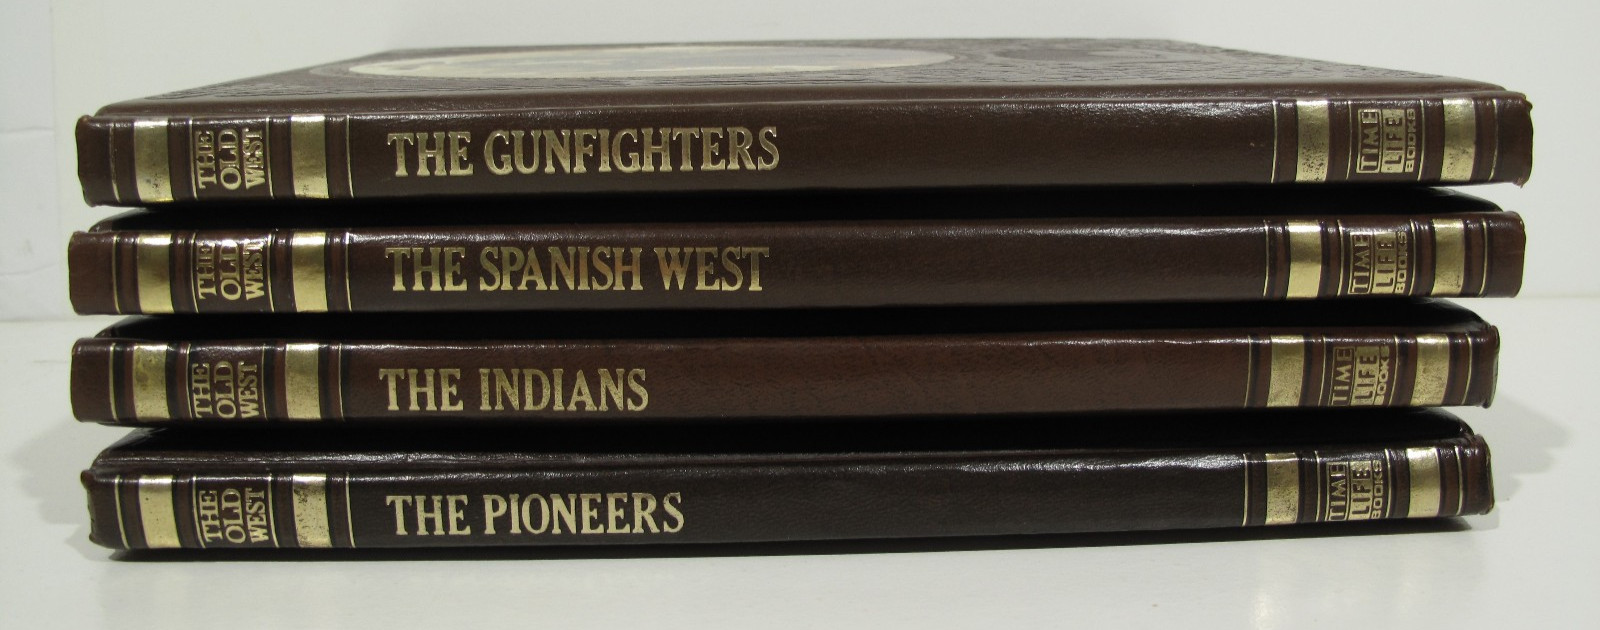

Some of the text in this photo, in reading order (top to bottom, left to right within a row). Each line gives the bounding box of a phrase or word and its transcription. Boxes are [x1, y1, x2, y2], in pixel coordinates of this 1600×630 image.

[195, 130, 217, 189] THE
[218, 128, 241, 190] OLD
[242, 128, 265, 190] WEST
[387, 126, 780, 177] THE GUNFIGHTERS
[1360, 109, 1379, 172] TIME
[1384, 117, 1403, 165] LIFE
[1405, 109, 1416, 173] BOOKS
[196, 242, 217, 300] THE
[219, 240, 242, 300] OLD
[242, 240, 265, 301] WEST
[385, 246, 770, 292] THE SPANISH WEST
[1352, 234, 1371, 294] TIME
[1375, 241, 1395, 288] LIFE
[192, 362, 213, 419] THE
[214, 360, 237, 419] OLD
[238, 360, 260, 419] WEST
[379, 367, 649, 412] THE INDIANS
[1331, 348, 1352, 406] TIME
[1355, 355, 1378, 400] LIFE
[200, 490, 223, 542] THE
[221, 488, 246, 544] OLD
[245, 488, 269, 543] WEST
[386, 491, 685, 536] THE PIONEERS
[1329, 464, 1347, 520] TIME
[1351, 467, 1372, 516] LIFE
[1371, 459, 1384, 519] BOOKS
